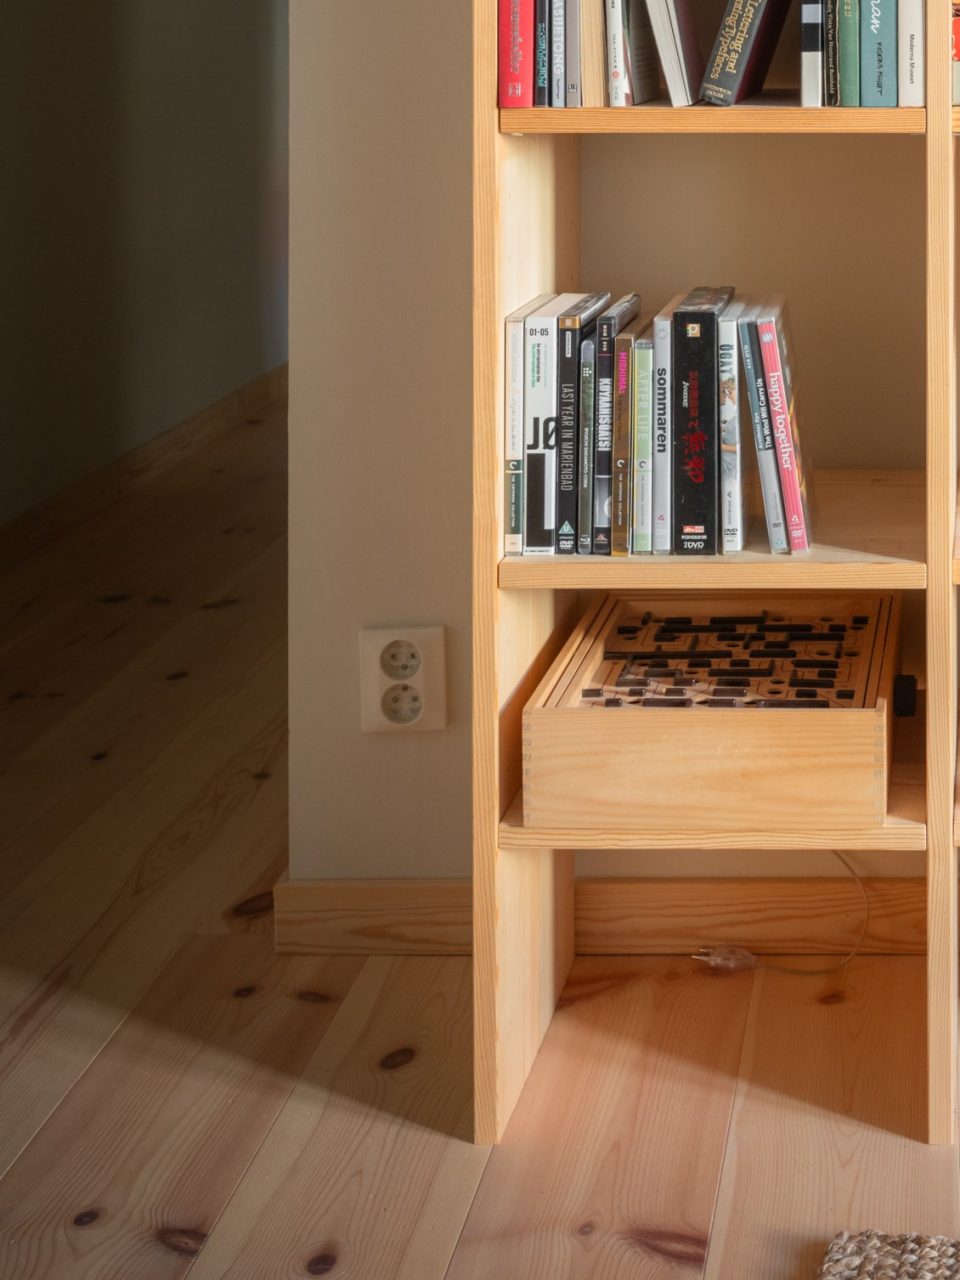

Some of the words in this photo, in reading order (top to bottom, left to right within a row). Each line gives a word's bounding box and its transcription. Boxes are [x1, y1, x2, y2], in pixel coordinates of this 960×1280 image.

[731, 0, 761, 51] Lettering
[710, 26, 737, 80] Typefaces
[529, 328, 549, 336] 01-05
[618, 352, 627, 394] MISHIMA:
[637, 370, 649, 407] AFTER
[769, 372, 786, 411] happy
[561, 384, 574, 404] LAST
[657, 367, 667, 453] sommaren
[760, 406, 768, 418] Will
[561, 406, 574, 427] YEAR
[561, 429, 573, 437] IN
[637, 412, 649, 441] LIFE
[762, 420, 771, 436] Wind
[774, 412, 793, 471] together
[561, 441, 573, 491] MARIENBAD
